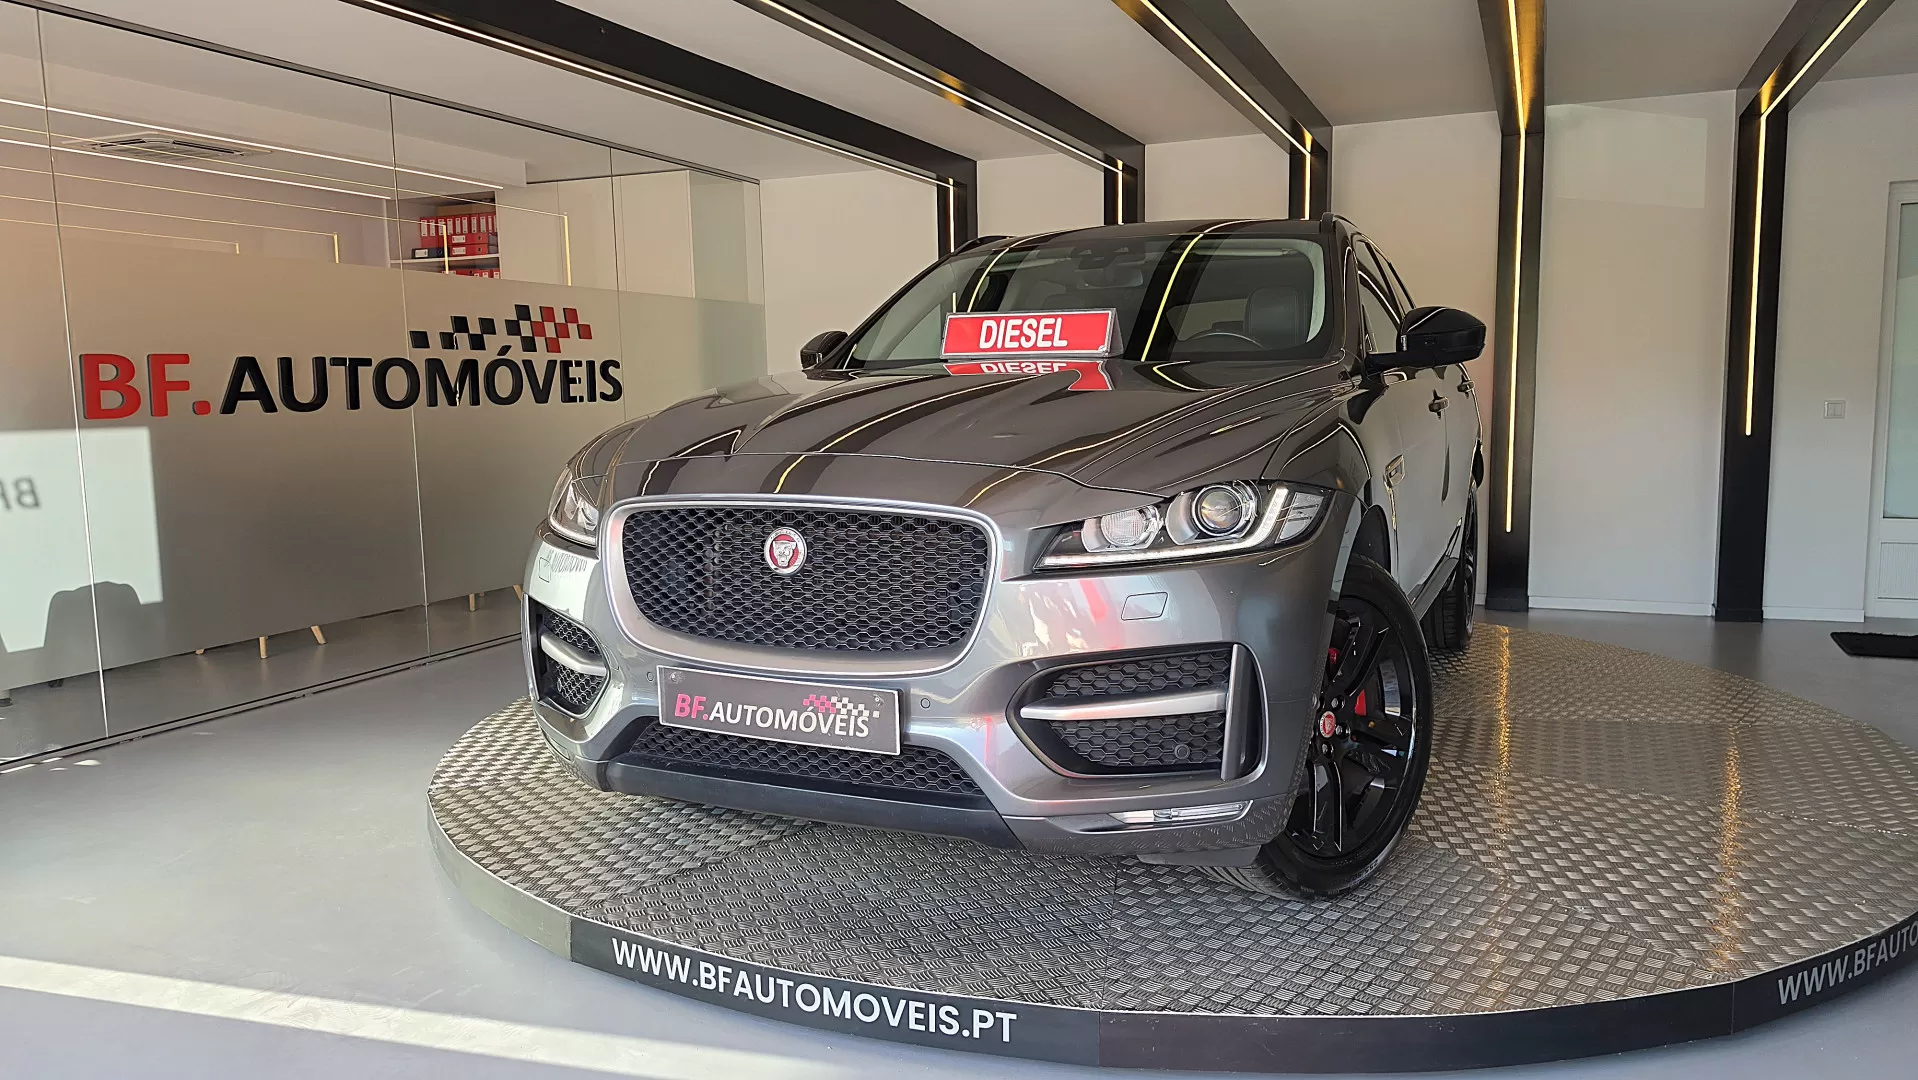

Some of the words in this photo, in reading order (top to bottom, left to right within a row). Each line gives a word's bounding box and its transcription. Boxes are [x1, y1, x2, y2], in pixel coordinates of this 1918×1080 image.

[979, 317, 1068, 349] DIESEL
[612, 937, 1018, 1042] WWW.BFAUTOMOVEIS.PT
[1778, 920, 1918, 1005] WWW.BFAUTO
